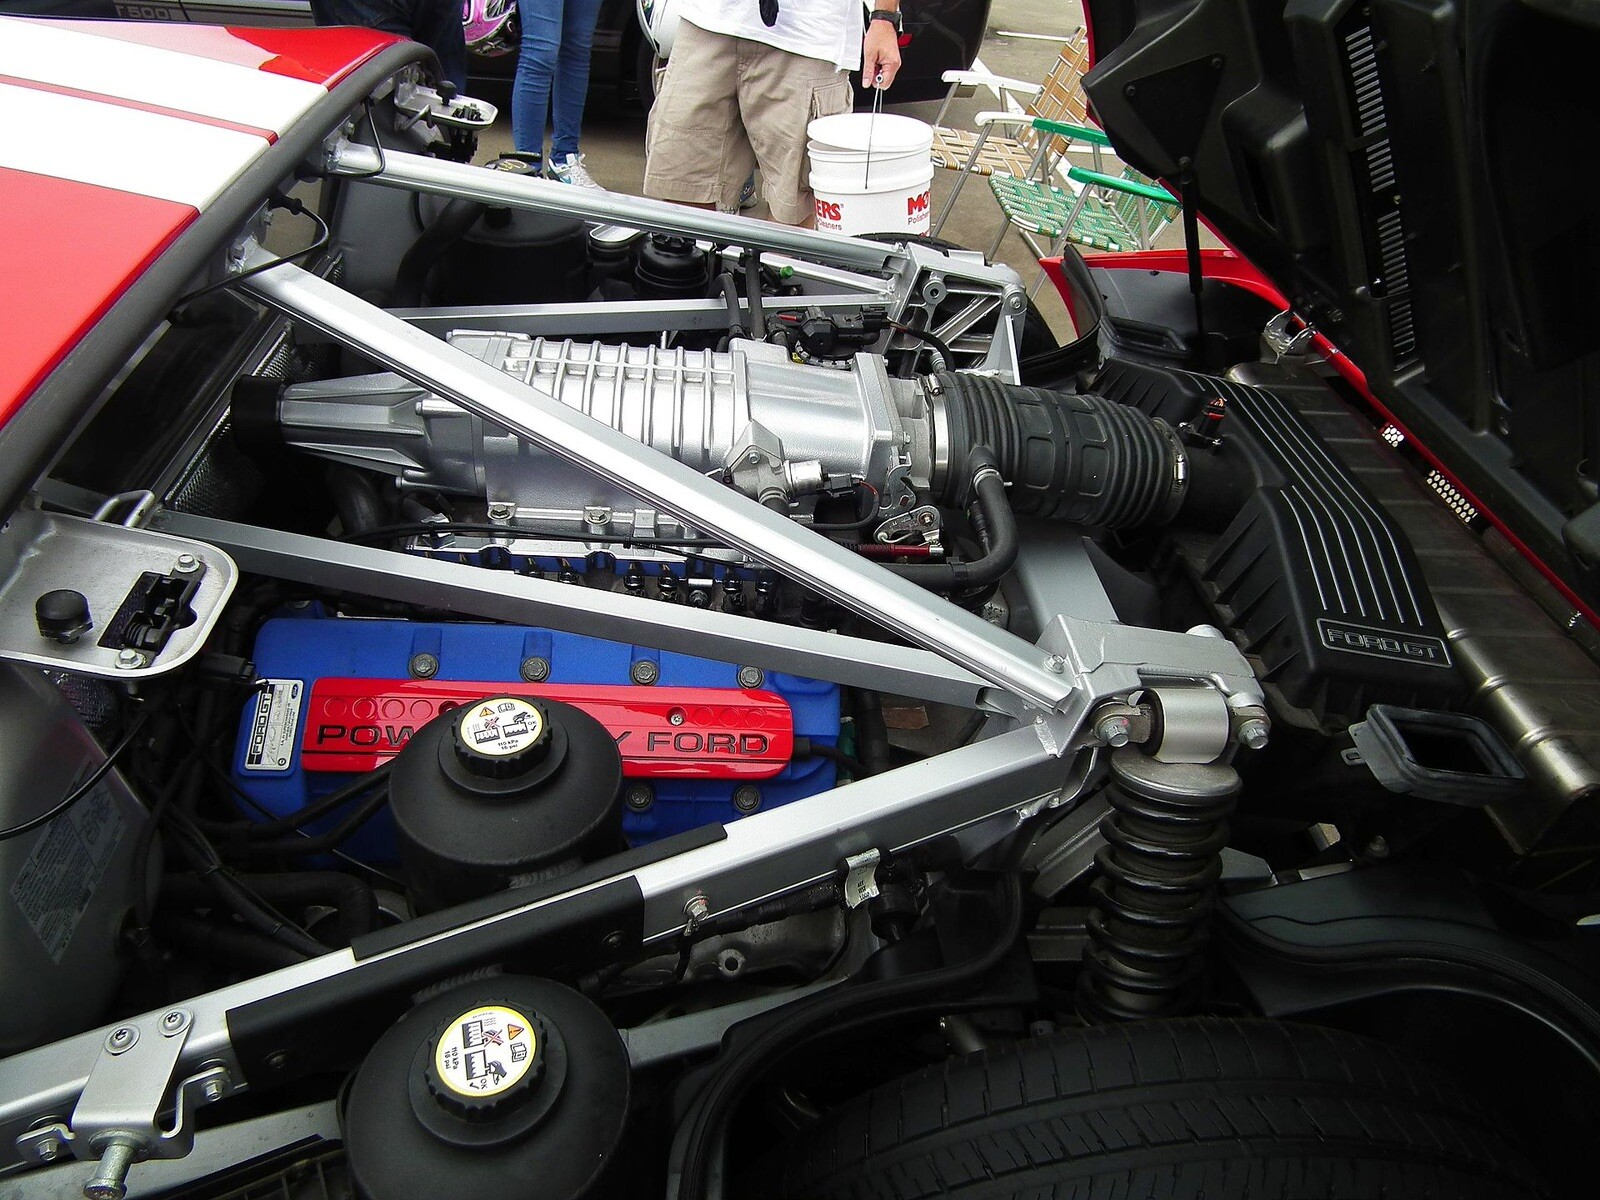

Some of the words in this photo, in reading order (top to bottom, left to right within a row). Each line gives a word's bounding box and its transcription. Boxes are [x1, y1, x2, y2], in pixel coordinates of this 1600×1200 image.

[1327, 628, 1400, 653] FORD
[1403, 641, 1438, 659] GT
[252, 715, 267, 754] FORD
[260, 694, 271, 714] GT
[317, 725, 415, 747] POW
[647, 731, 770, 755] FORD
